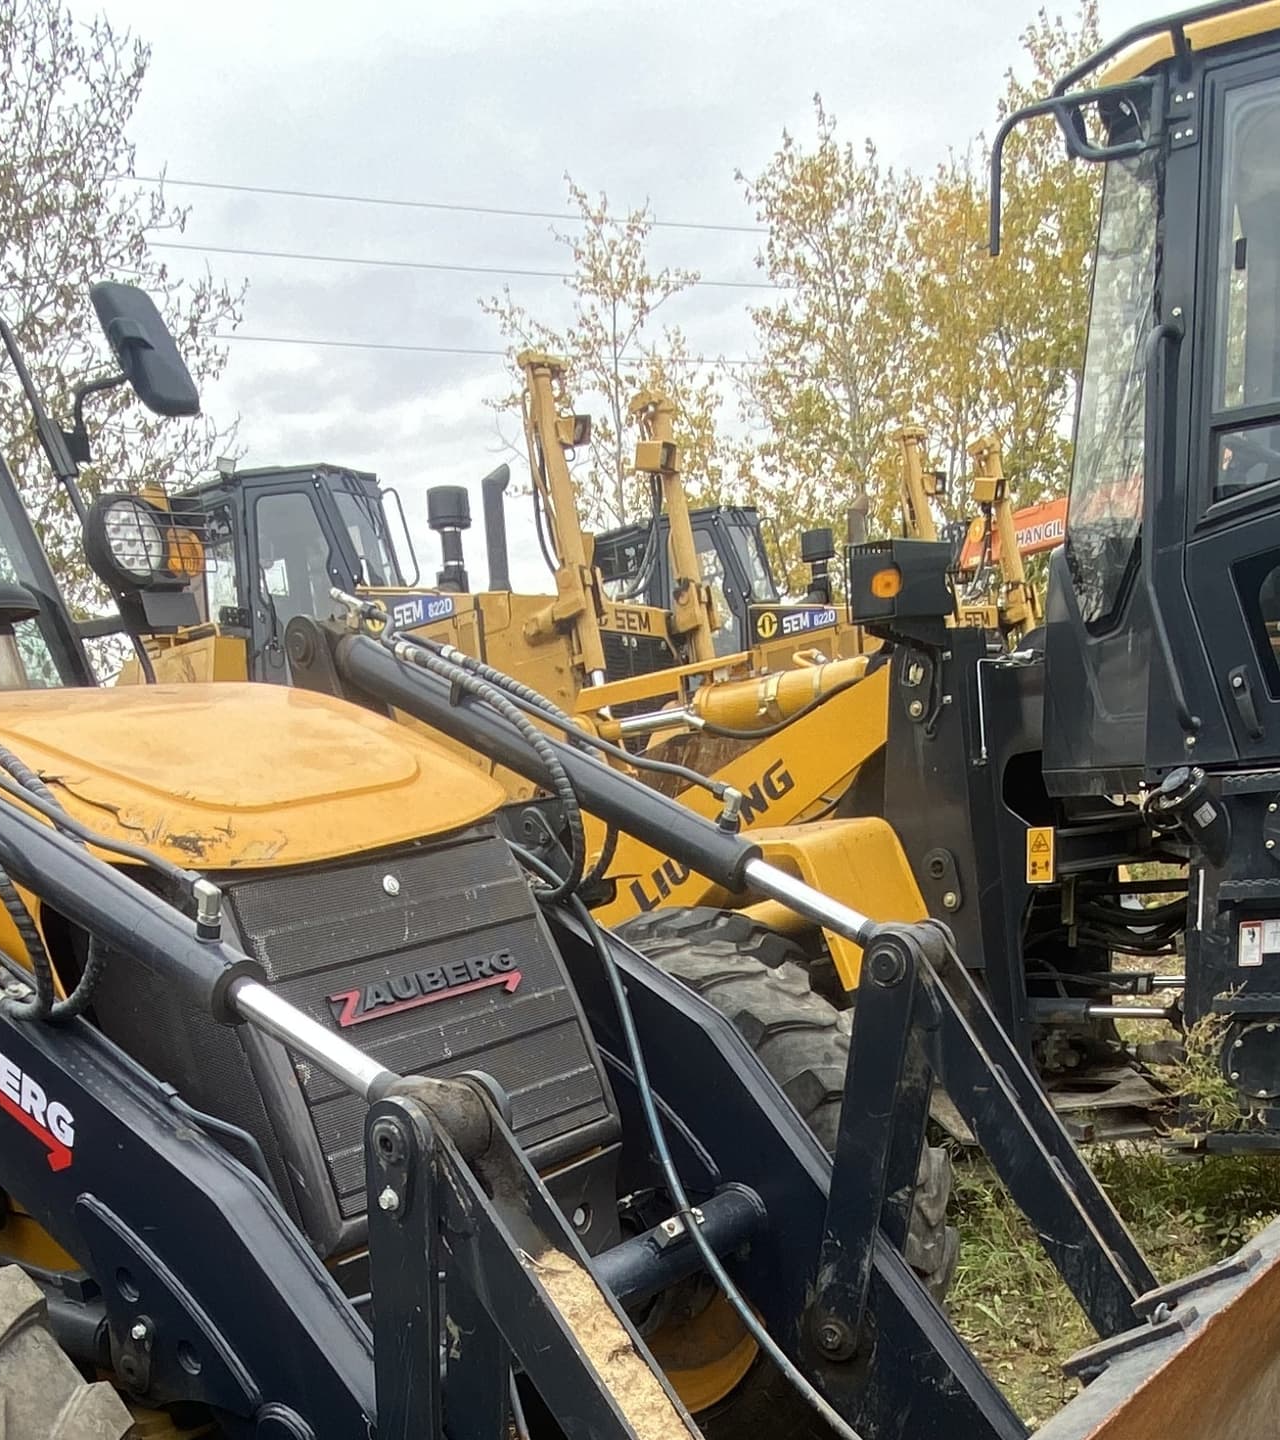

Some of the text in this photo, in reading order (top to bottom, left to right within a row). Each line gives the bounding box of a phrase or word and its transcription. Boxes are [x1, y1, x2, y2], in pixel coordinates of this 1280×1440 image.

[393, 597, 453, 628] SEM 822D
[614, 608, 651, 633] SEM
[782, 611, 810, 634] SEM
[629, 758, 795, 913] LIUNG
[328, 948, 523, 1027] ZAUBERG
